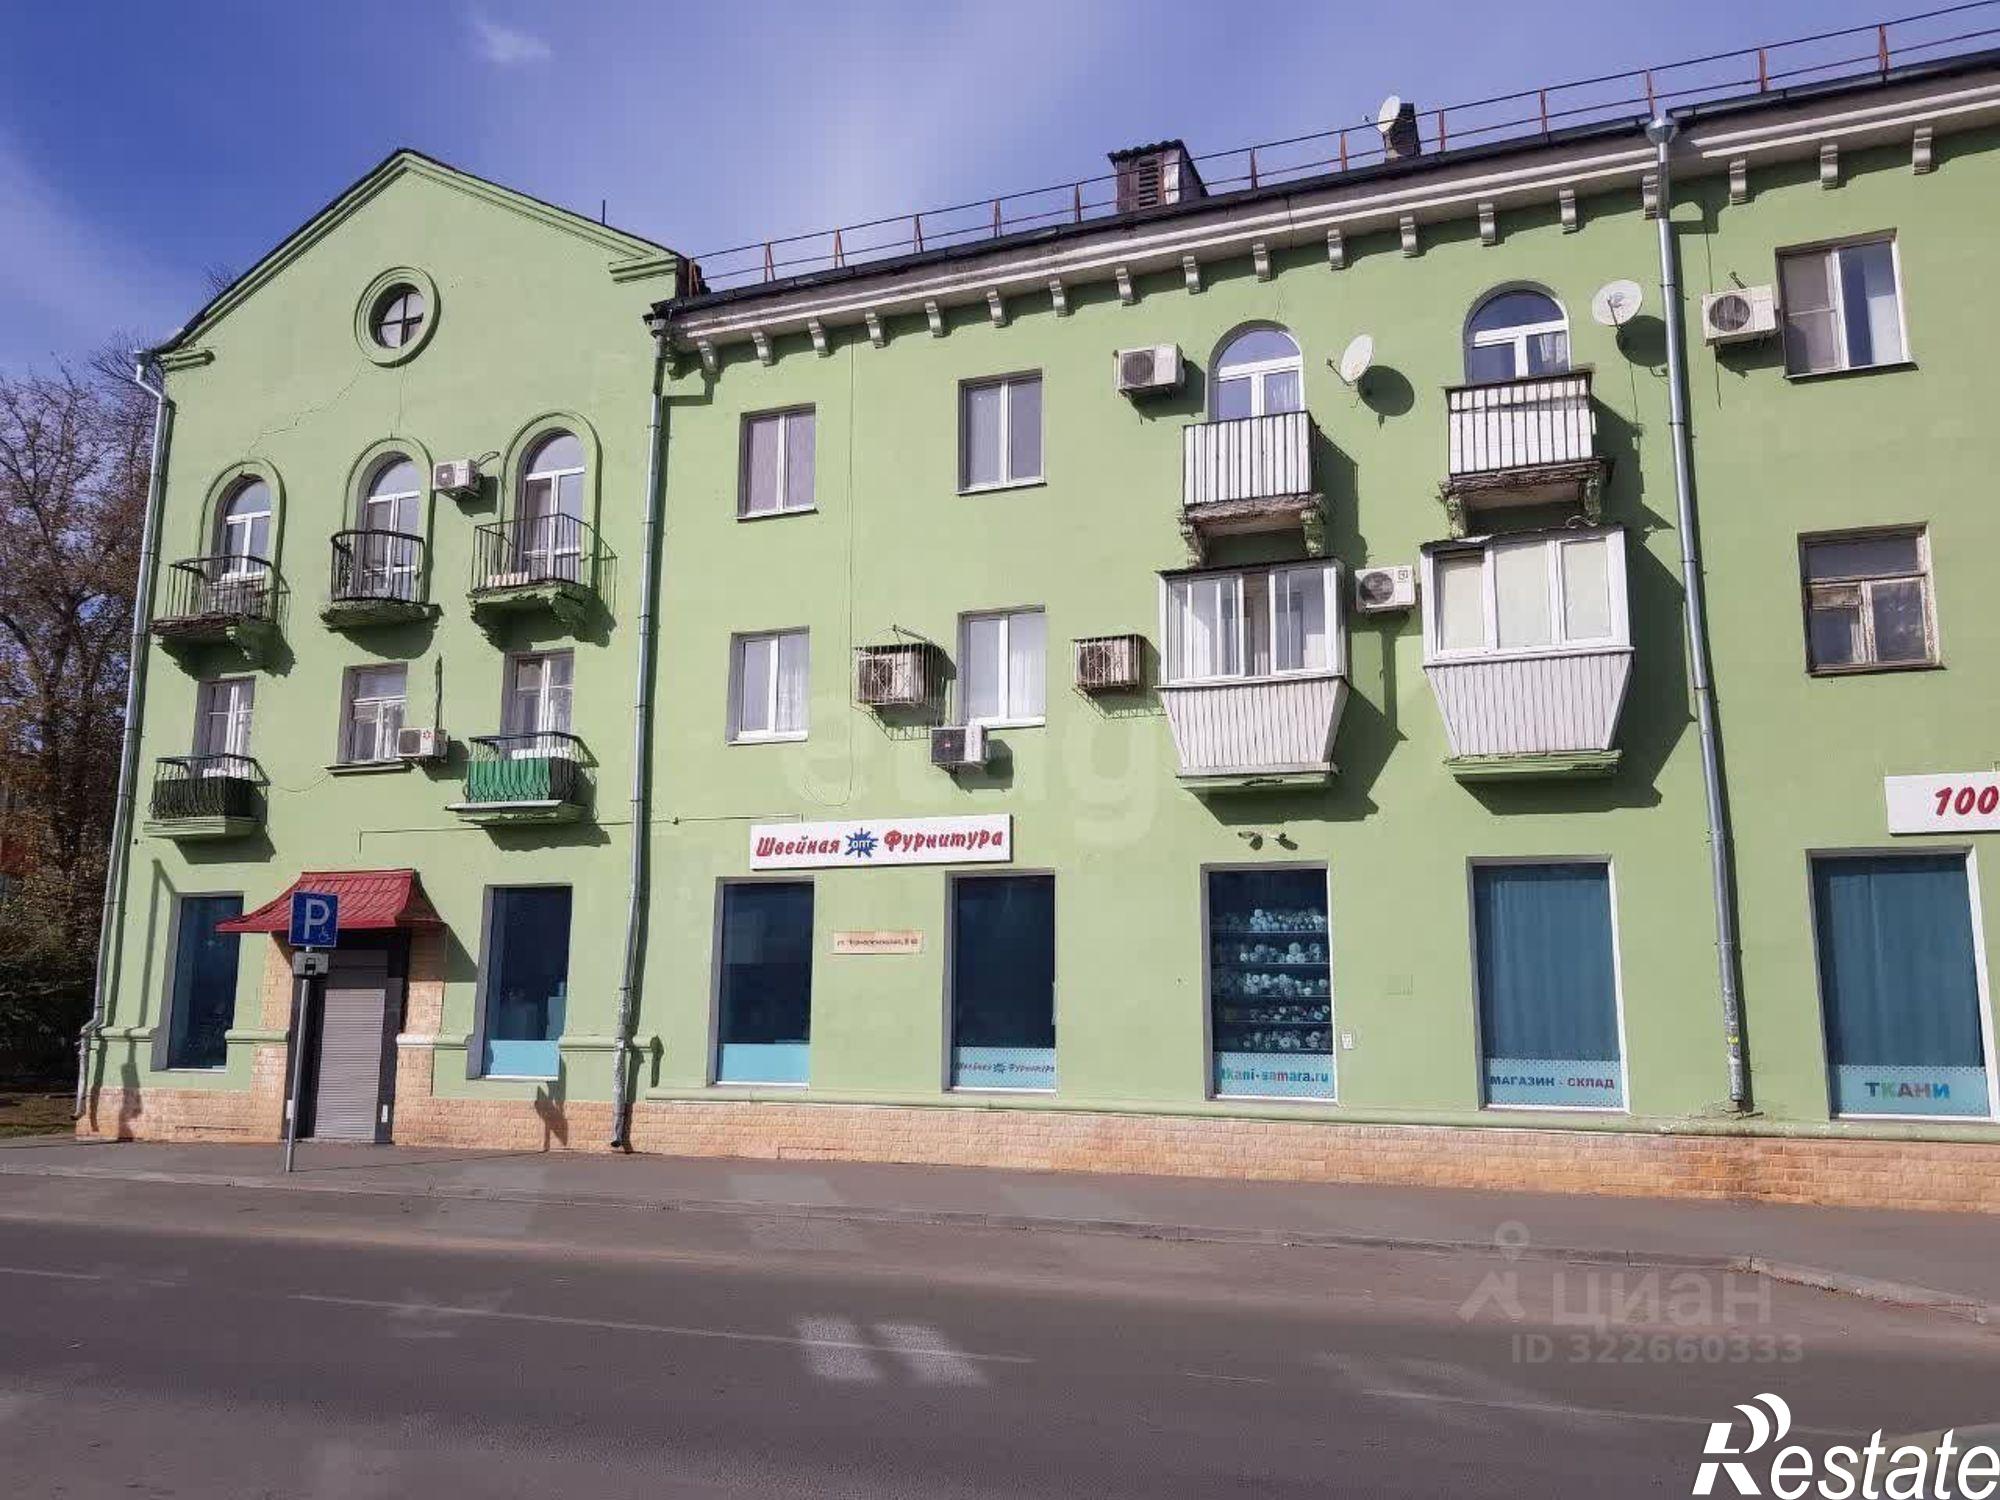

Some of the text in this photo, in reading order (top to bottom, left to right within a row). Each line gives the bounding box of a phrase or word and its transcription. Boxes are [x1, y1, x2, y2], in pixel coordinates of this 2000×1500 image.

[1935, 785, 2000, 816] 100
[756, 835, 840, 857] Швейная
[884, 829, 1003, 852] Фурнитура
[303, 898, 330, 940] P
[1221, 1068, 1329, 1083] tkani-samara.ru
[1489, 1075, 1555, 1087] МАГАЗИН
[1567, 1077, 1615, 1089] СКЛАД
[1864, 1081, 1950, 1099] ТКАНИ
